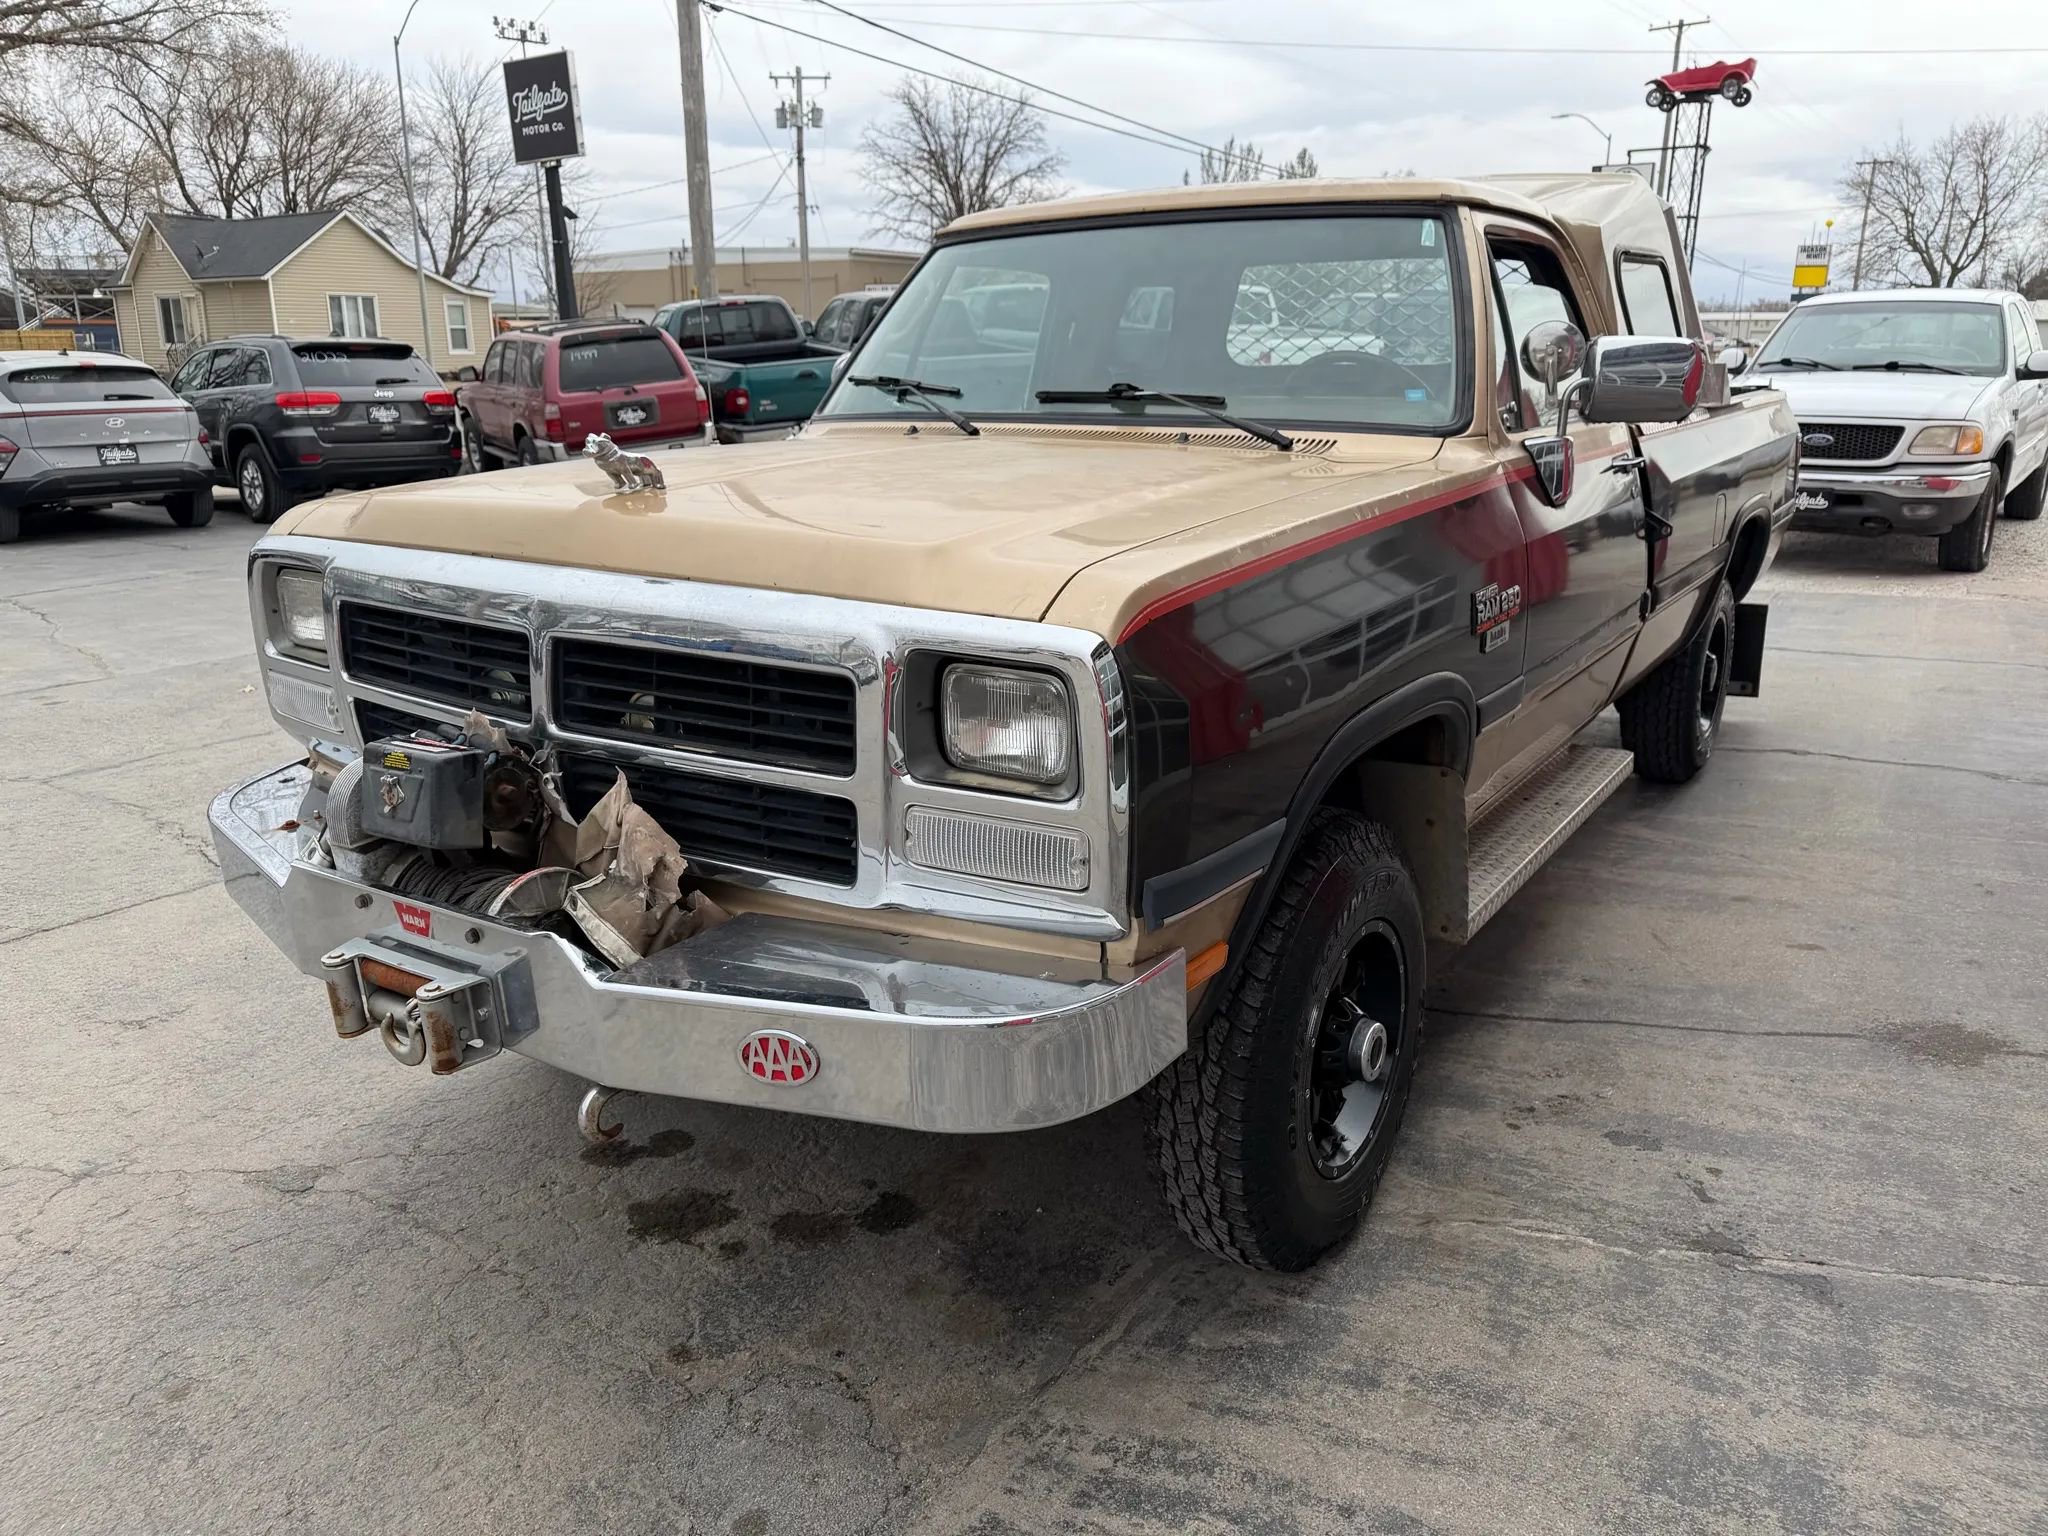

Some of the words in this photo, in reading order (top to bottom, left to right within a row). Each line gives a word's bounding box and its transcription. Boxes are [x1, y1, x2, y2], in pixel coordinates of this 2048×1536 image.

[512, 80, 568, 123] Tailgate
[522, 123, 550, 136] MOTOR
[1800, 245, 1827, 253] JACKSON
[374, 388, 395, 398] Jeep
[100, 447, 137, 462] Tailgate
[1475, 585, 1499, 604] POWER
[1476, 595, 1500, 625] RAM
[1501, 584, 1521, 612] 250
[401, 911, 426, 929] WARN
[747, 1032, 810, 1085] AAA
